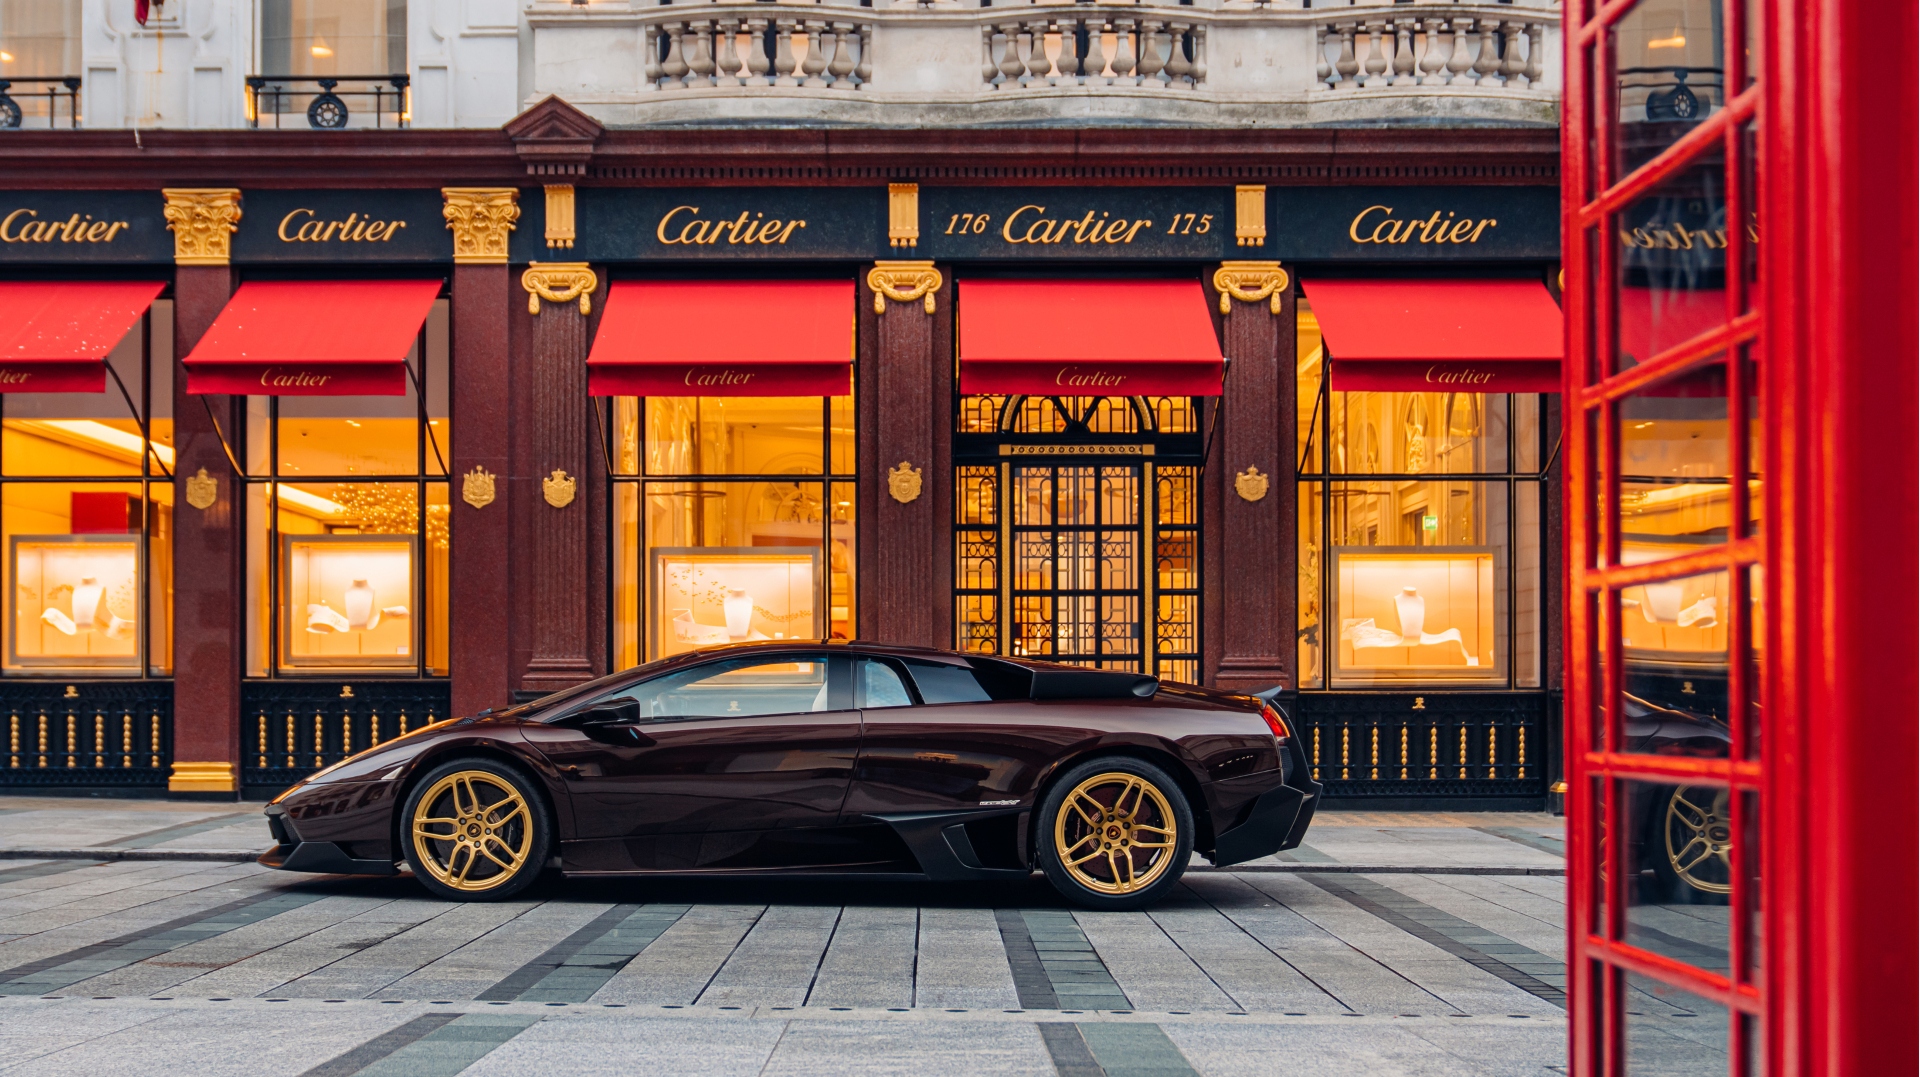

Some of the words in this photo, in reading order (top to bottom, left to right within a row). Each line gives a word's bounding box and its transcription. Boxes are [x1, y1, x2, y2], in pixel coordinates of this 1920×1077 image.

[0, 208, 129, 243] Cartier
[277, 208, 406, 243] Cartier
[657, 205, 807, 245] Cartier
[945, 213, 990, 236] 176
[1002, 205, 1152, 244] Cartier
[1167, 213, 1214, 236] 175
[1349, 205, 1497, 244] Cartier
[260, 367, 331, 386] Cartier
[684, 367, 755, 386] Cartier
[1056, 367, 1126, 387] Cartier
[1425, 366, 1496, 386] Cartier
